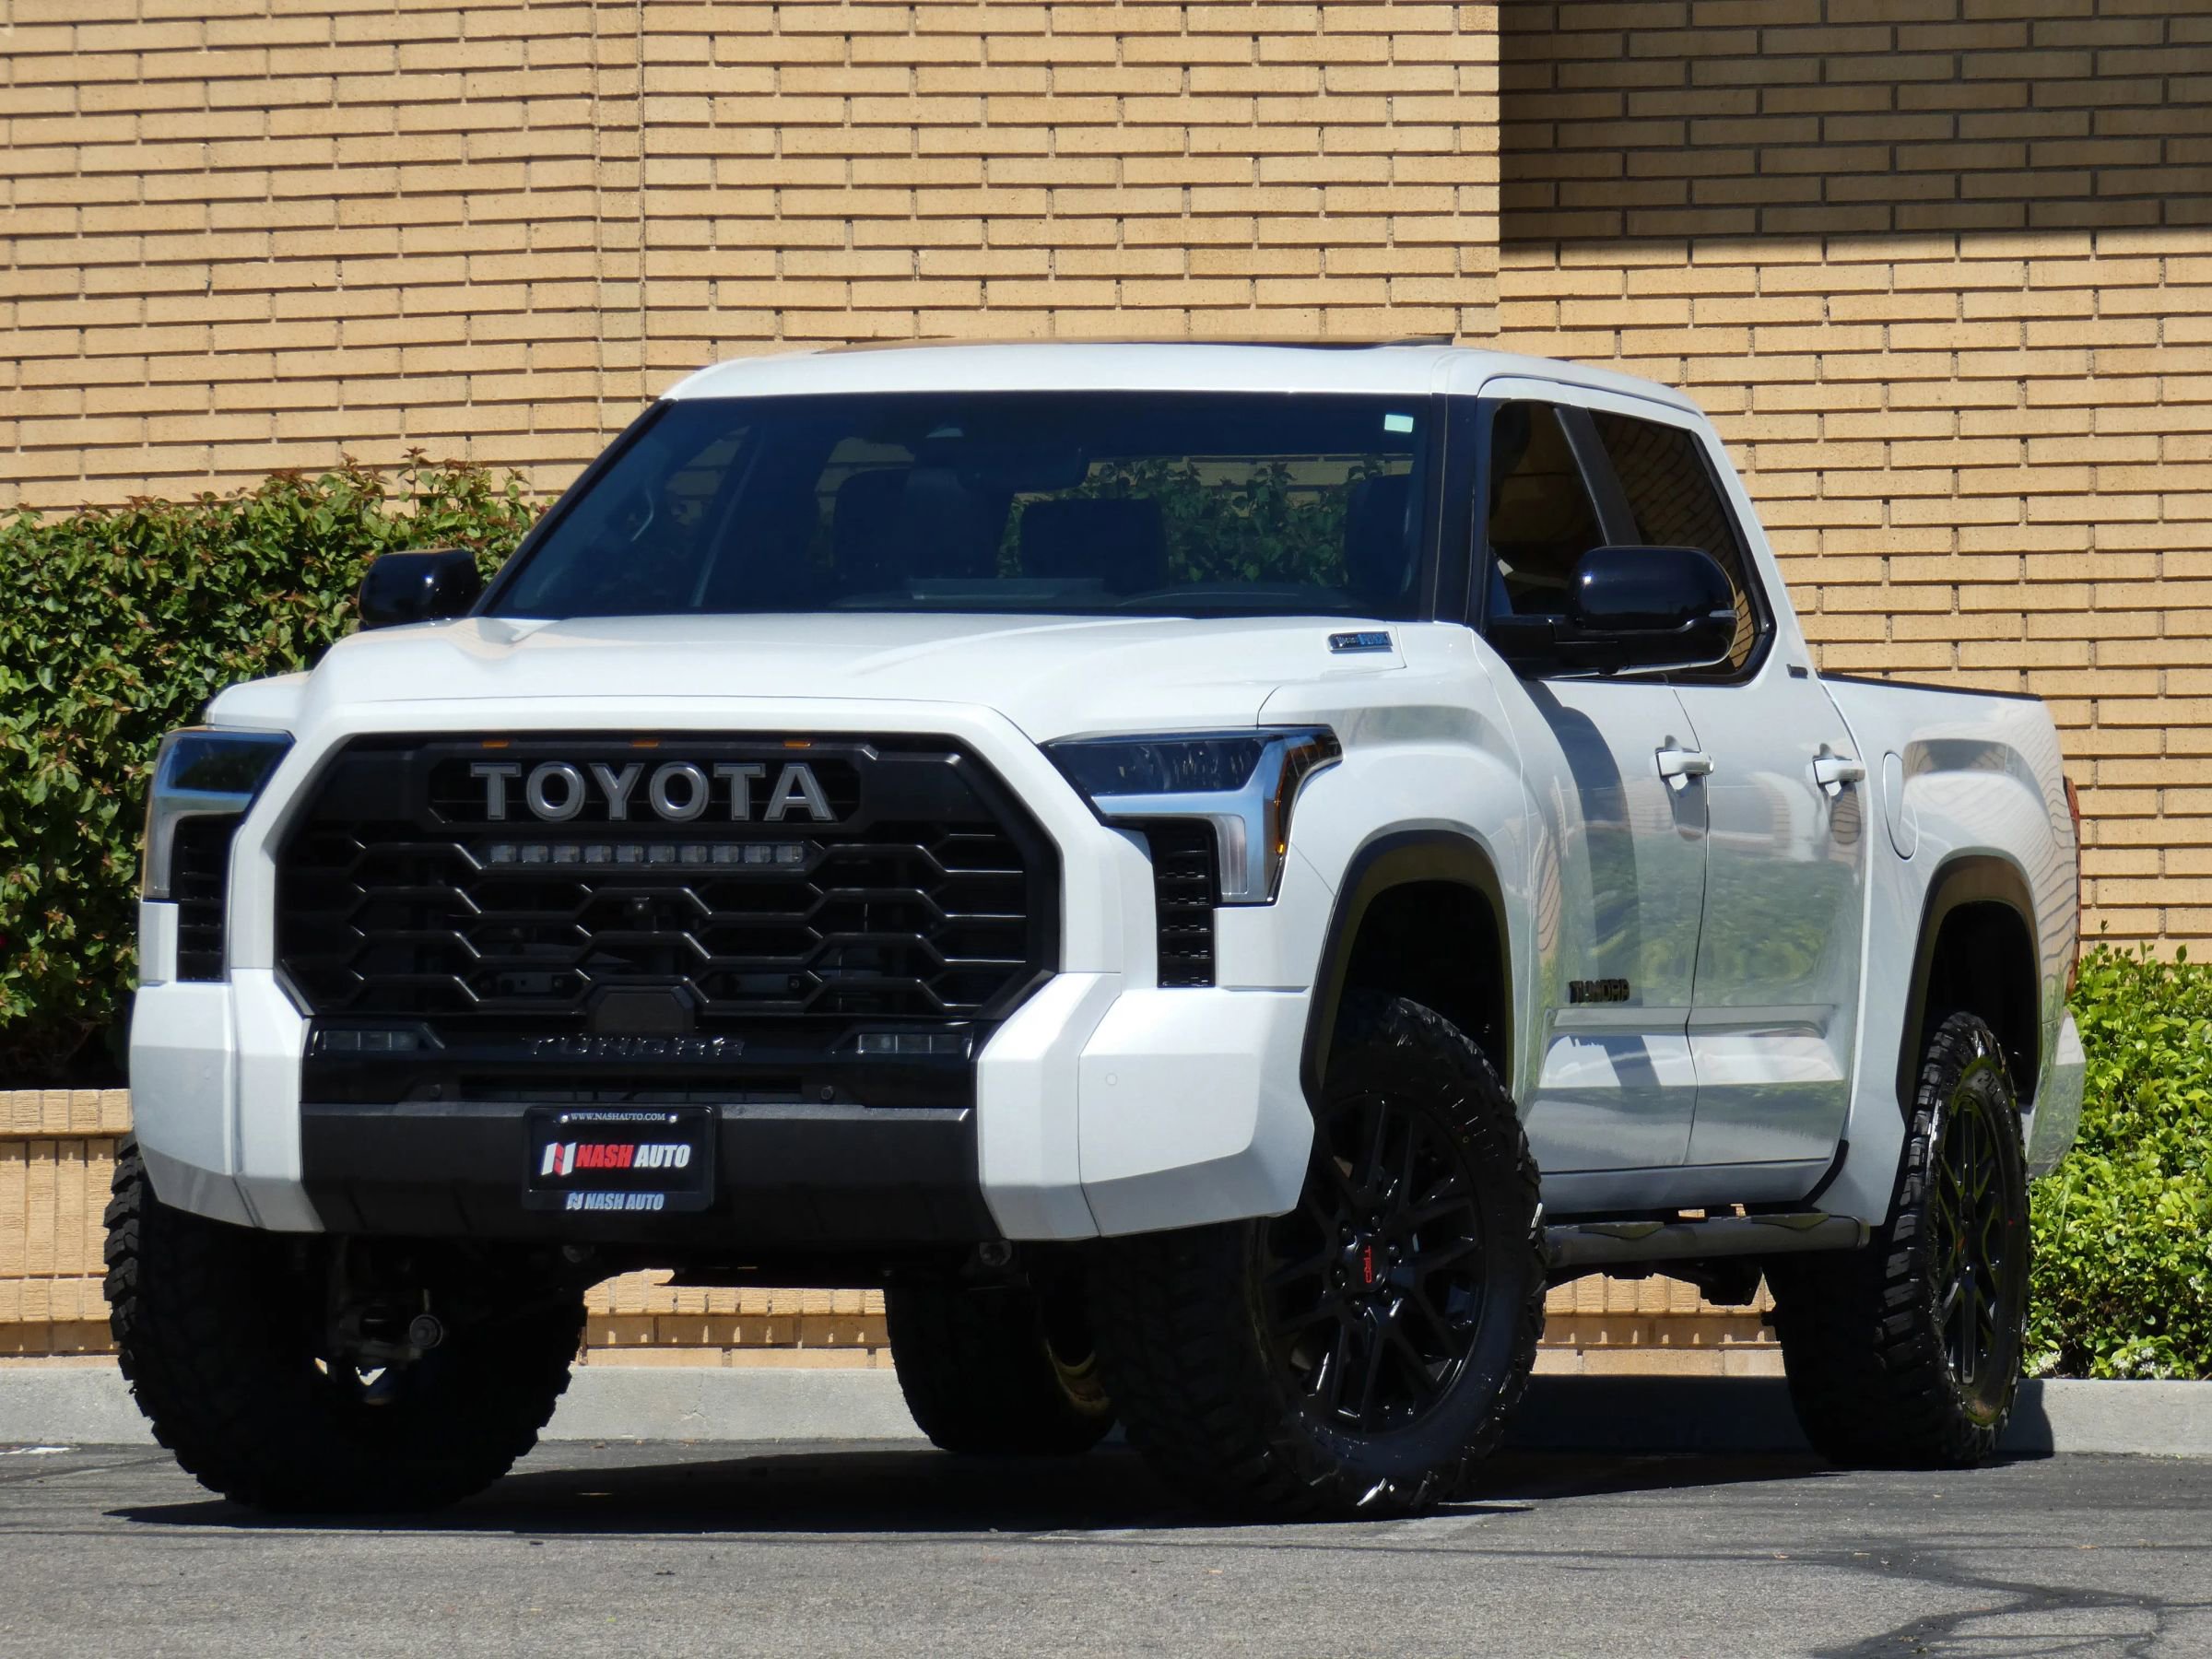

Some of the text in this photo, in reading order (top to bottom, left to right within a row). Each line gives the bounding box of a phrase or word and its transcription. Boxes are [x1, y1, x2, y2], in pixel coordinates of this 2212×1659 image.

[471, 760, 837, 823] TOYOTA
[571, 1112, 666, 1122] WWW.NASHAUTO.COM
[575, 1144, 635, 1169] NASH
[633, 1144, 691, 1169] AUTO
[583, 1193, 626, 1210] NASH
[625, 1193, 665, 1210] AUTO
